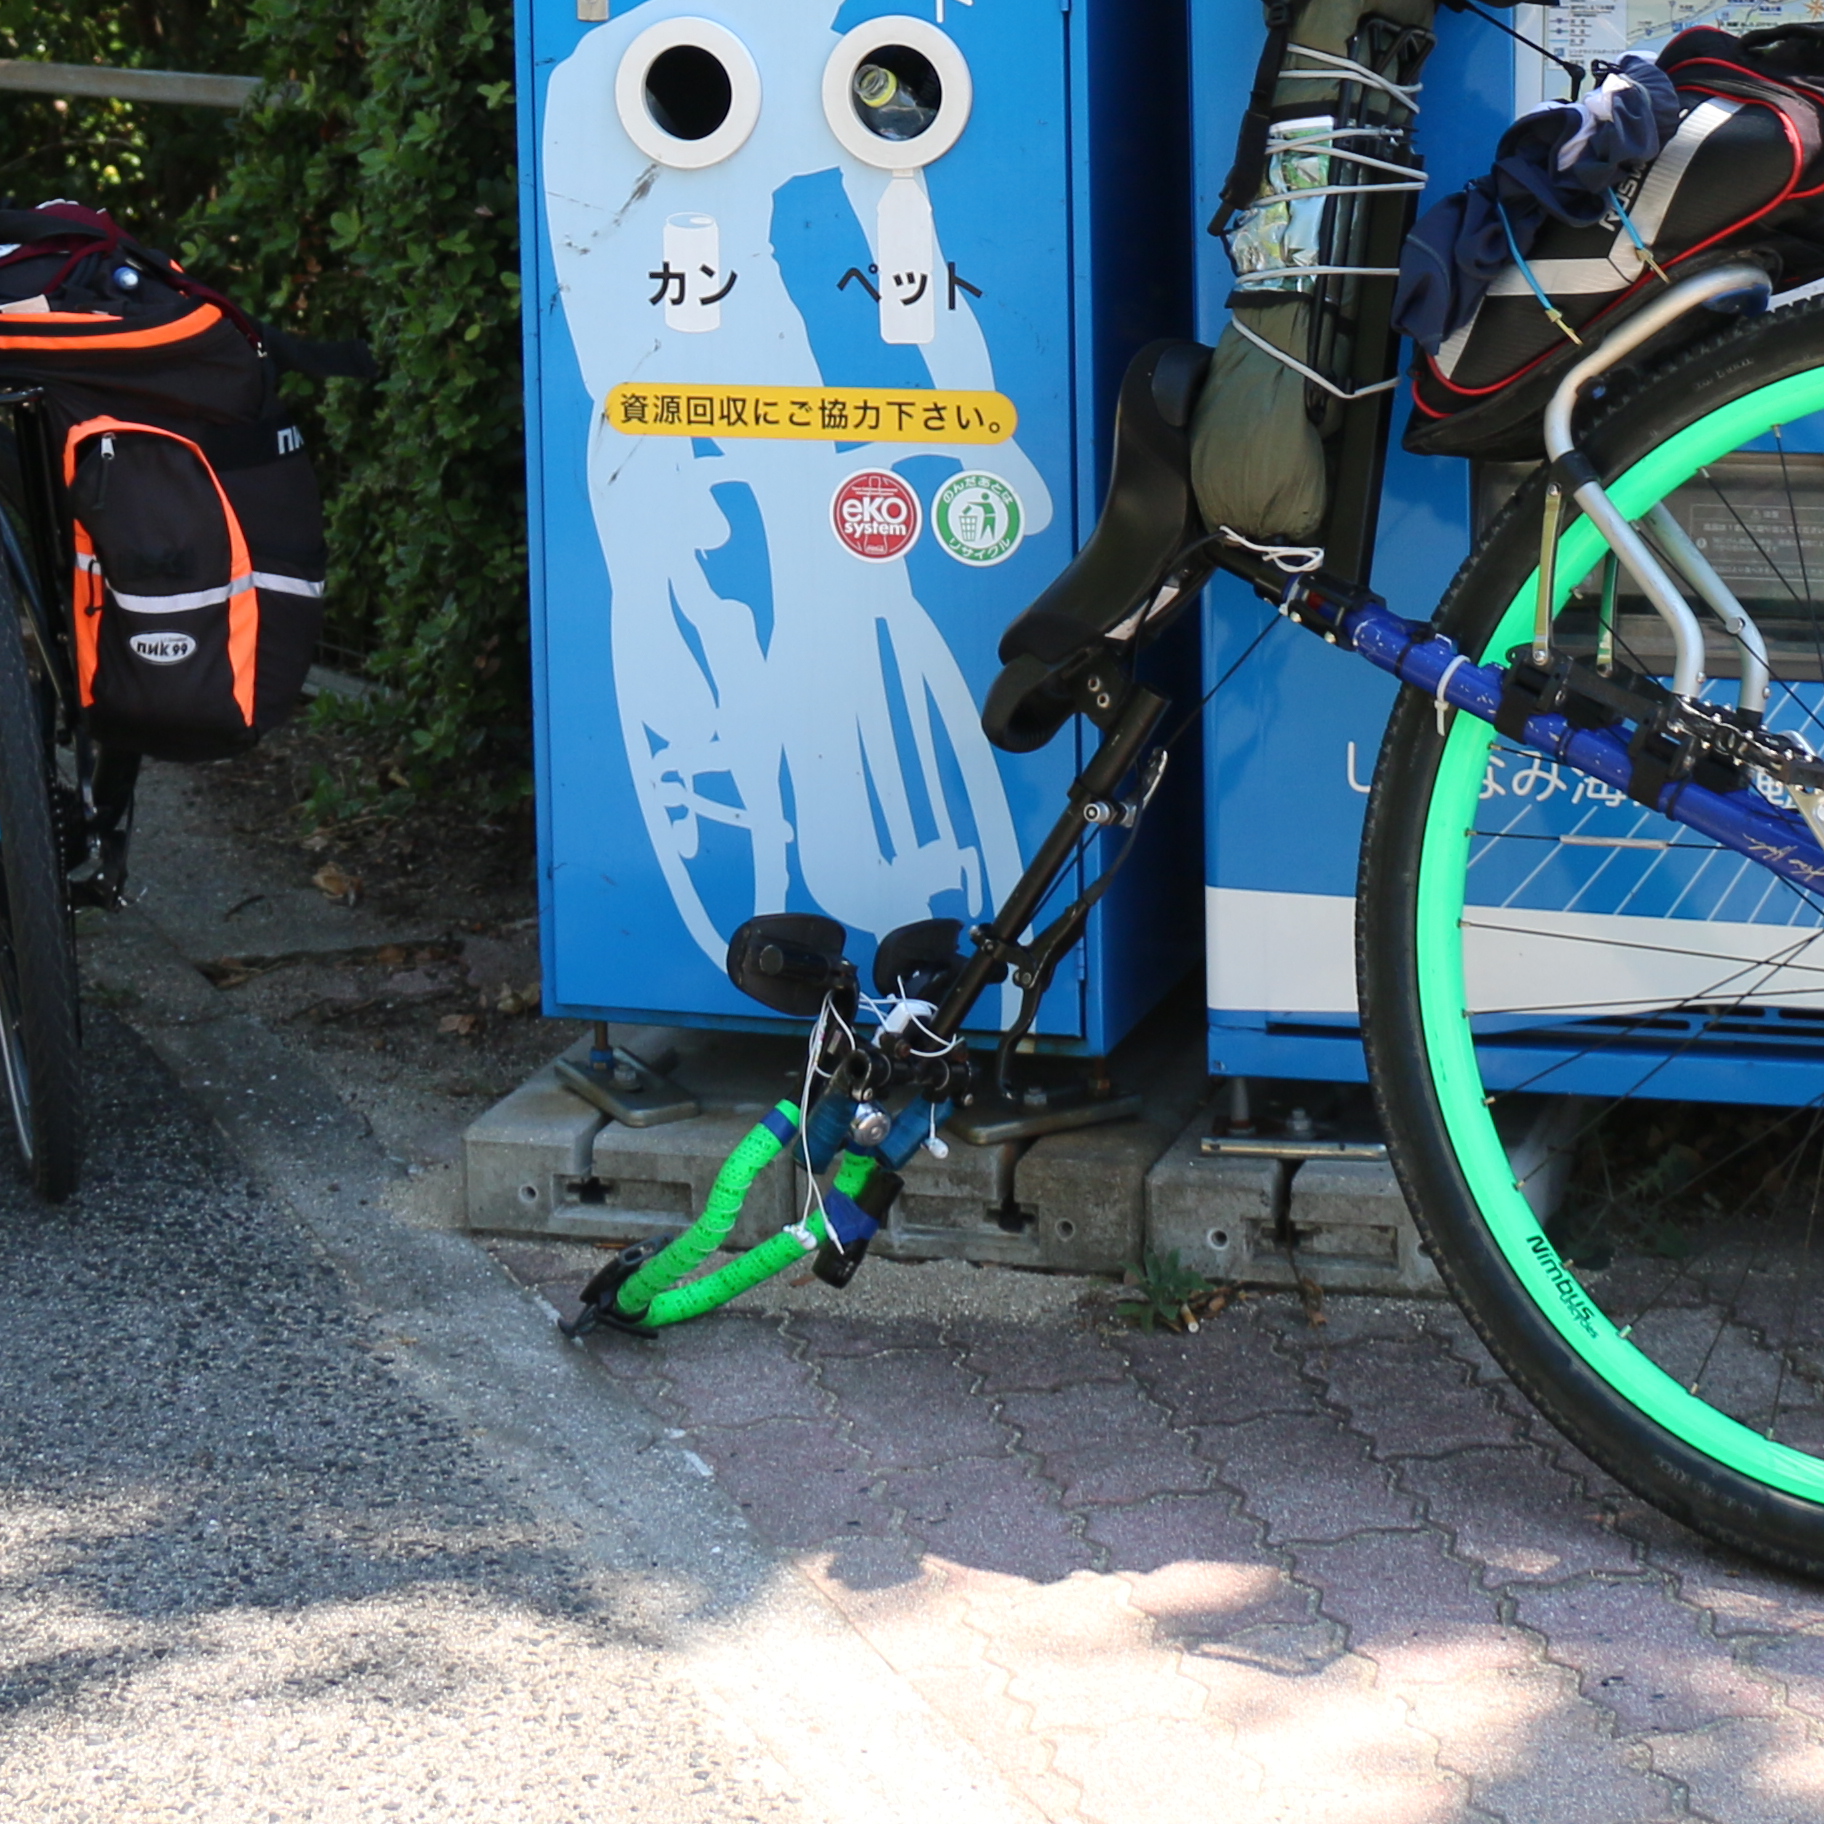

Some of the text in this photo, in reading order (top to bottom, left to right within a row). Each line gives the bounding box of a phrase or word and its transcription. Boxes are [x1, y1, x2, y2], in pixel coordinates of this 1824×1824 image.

[648, 261, 983, 311] カン ペット
[620, 392, 1002, 435] 資源回収にご協力下さい。
[942, 474, 1014, 505] のんだあとは
[844, 521, 907, 538] system
[948, 536, 1012, 560] リサイクル
[1526, 1234, 1596, 1320] Nimbus
